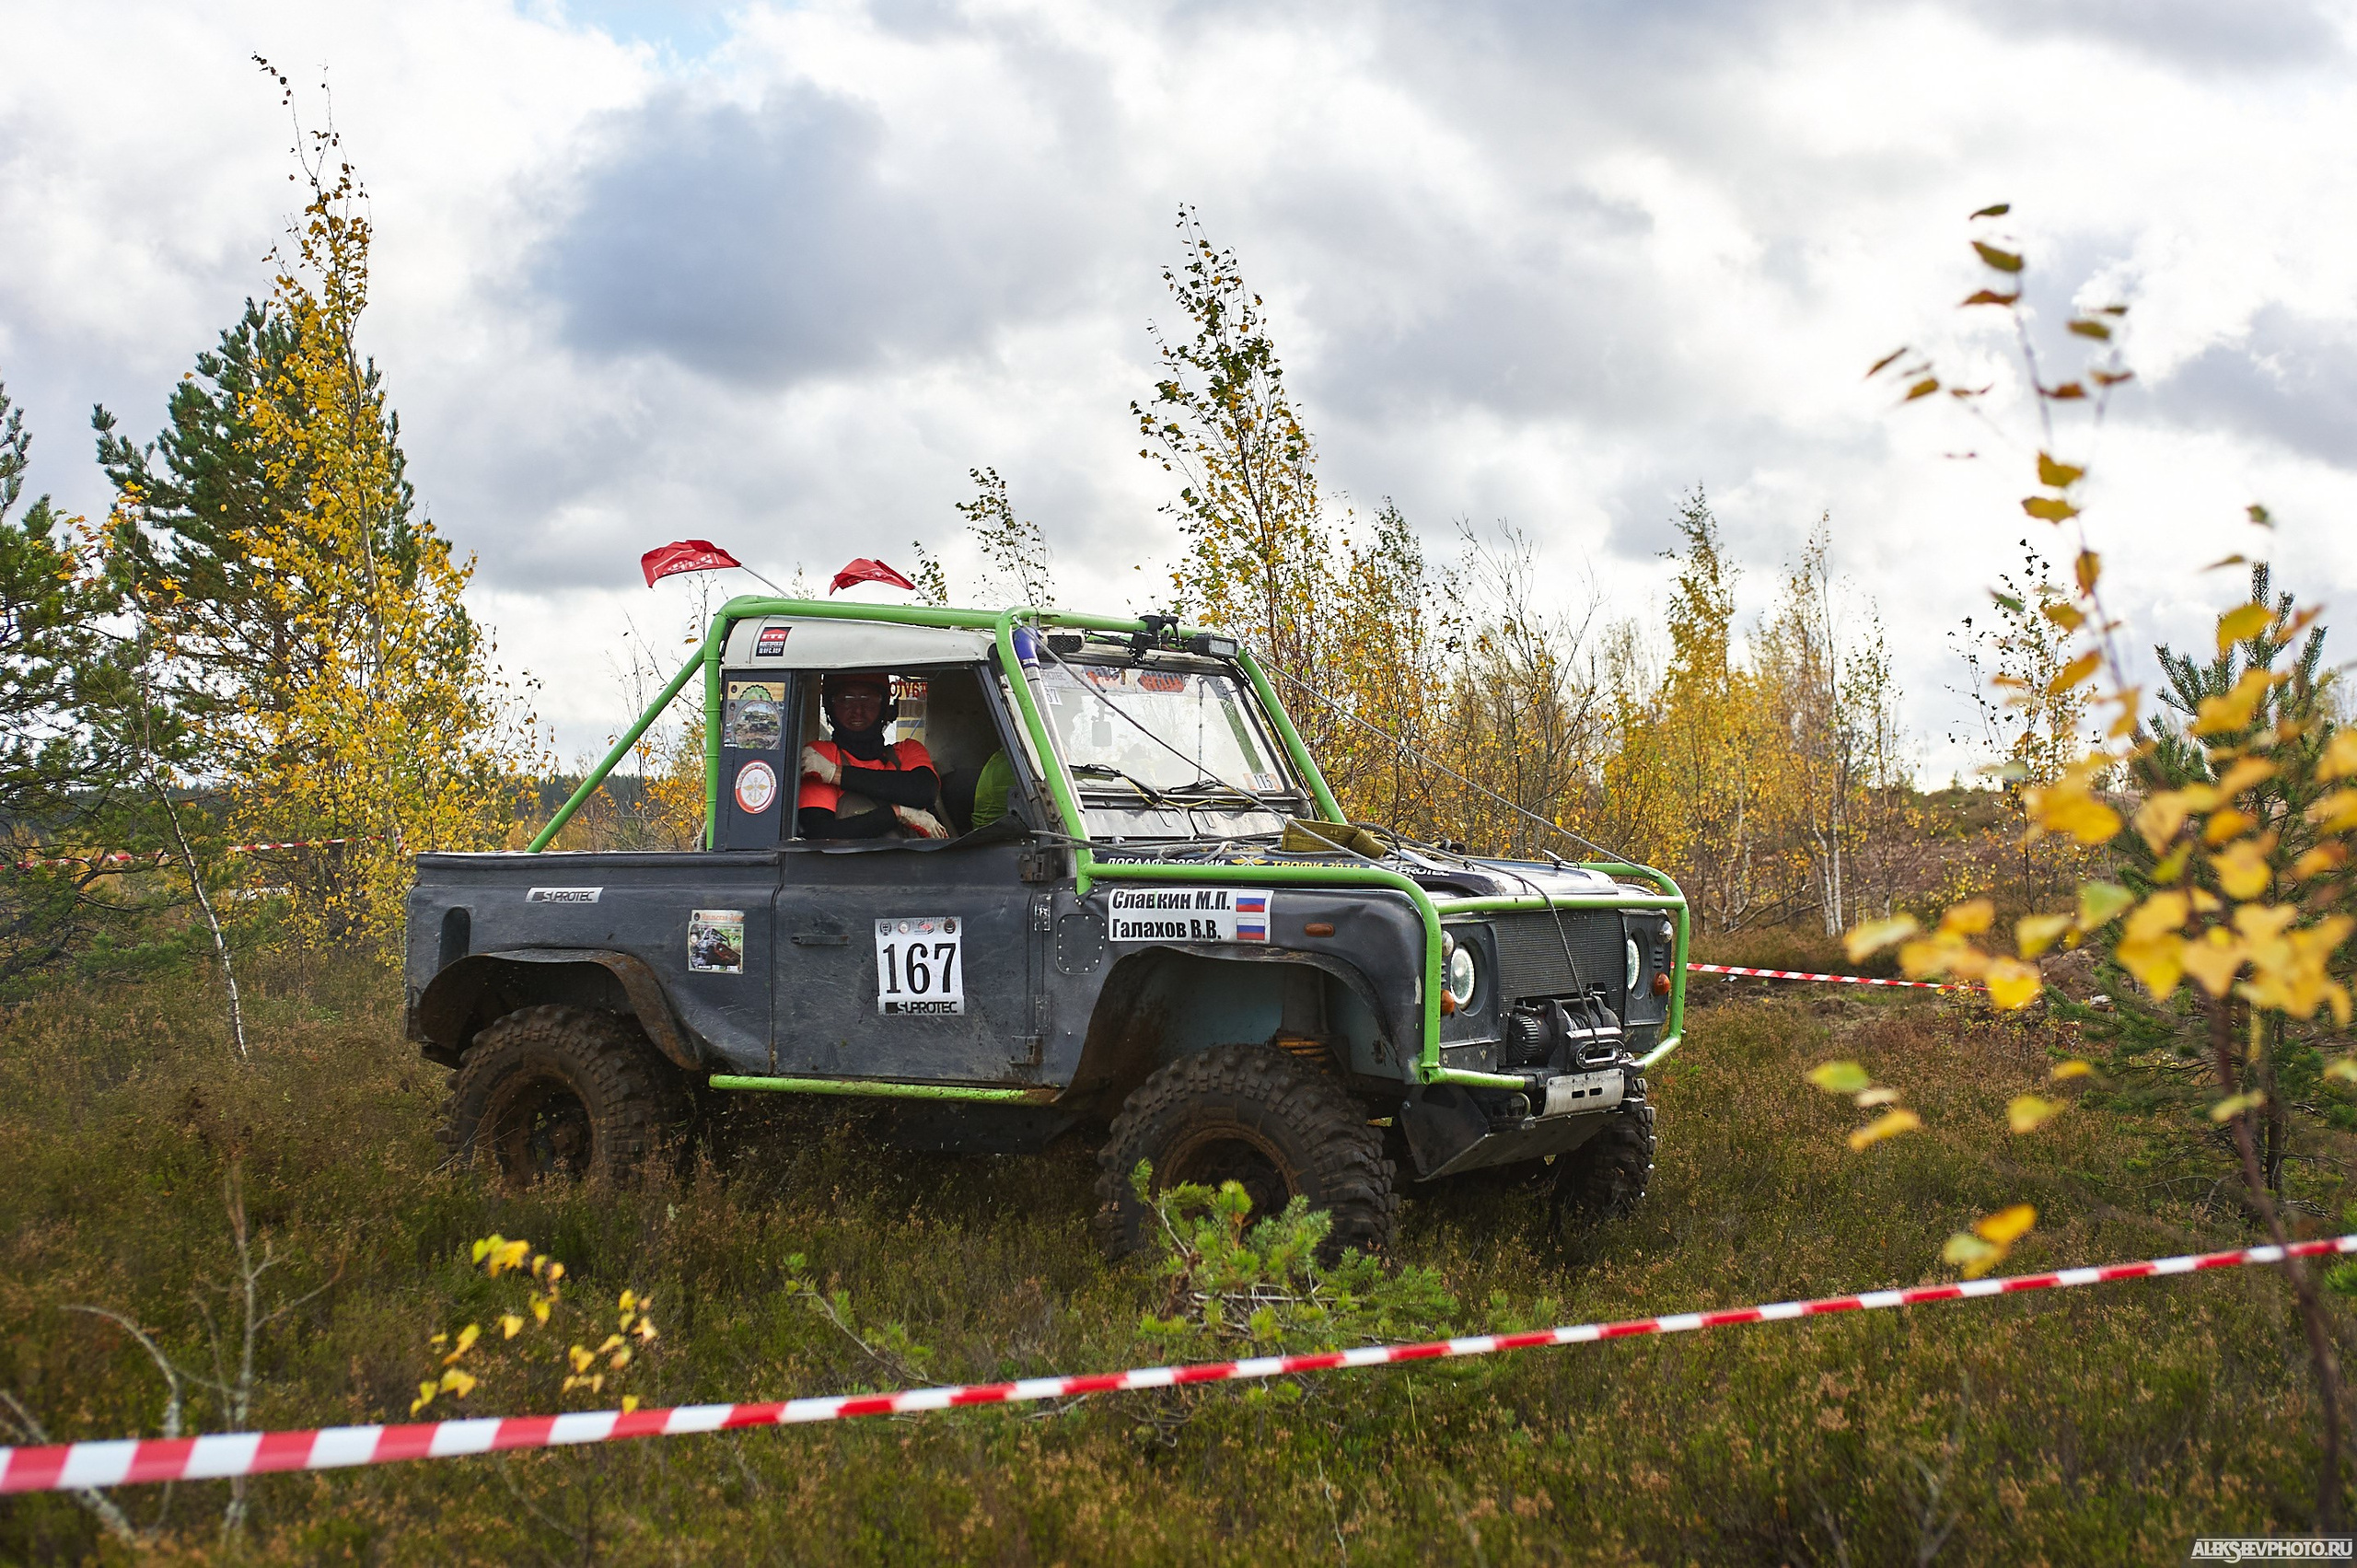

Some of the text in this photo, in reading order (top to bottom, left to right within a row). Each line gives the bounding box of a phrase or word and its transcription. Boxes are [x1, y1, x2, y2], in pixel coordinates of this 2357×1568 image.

[1112, 890, 1231, 911] Славкин М.П.
[1112, 918, 1222, 940] Галахов В.В.
[882, 942, 957, 995] 167
[896, 1001, 958, 1015] SUPROTEC
